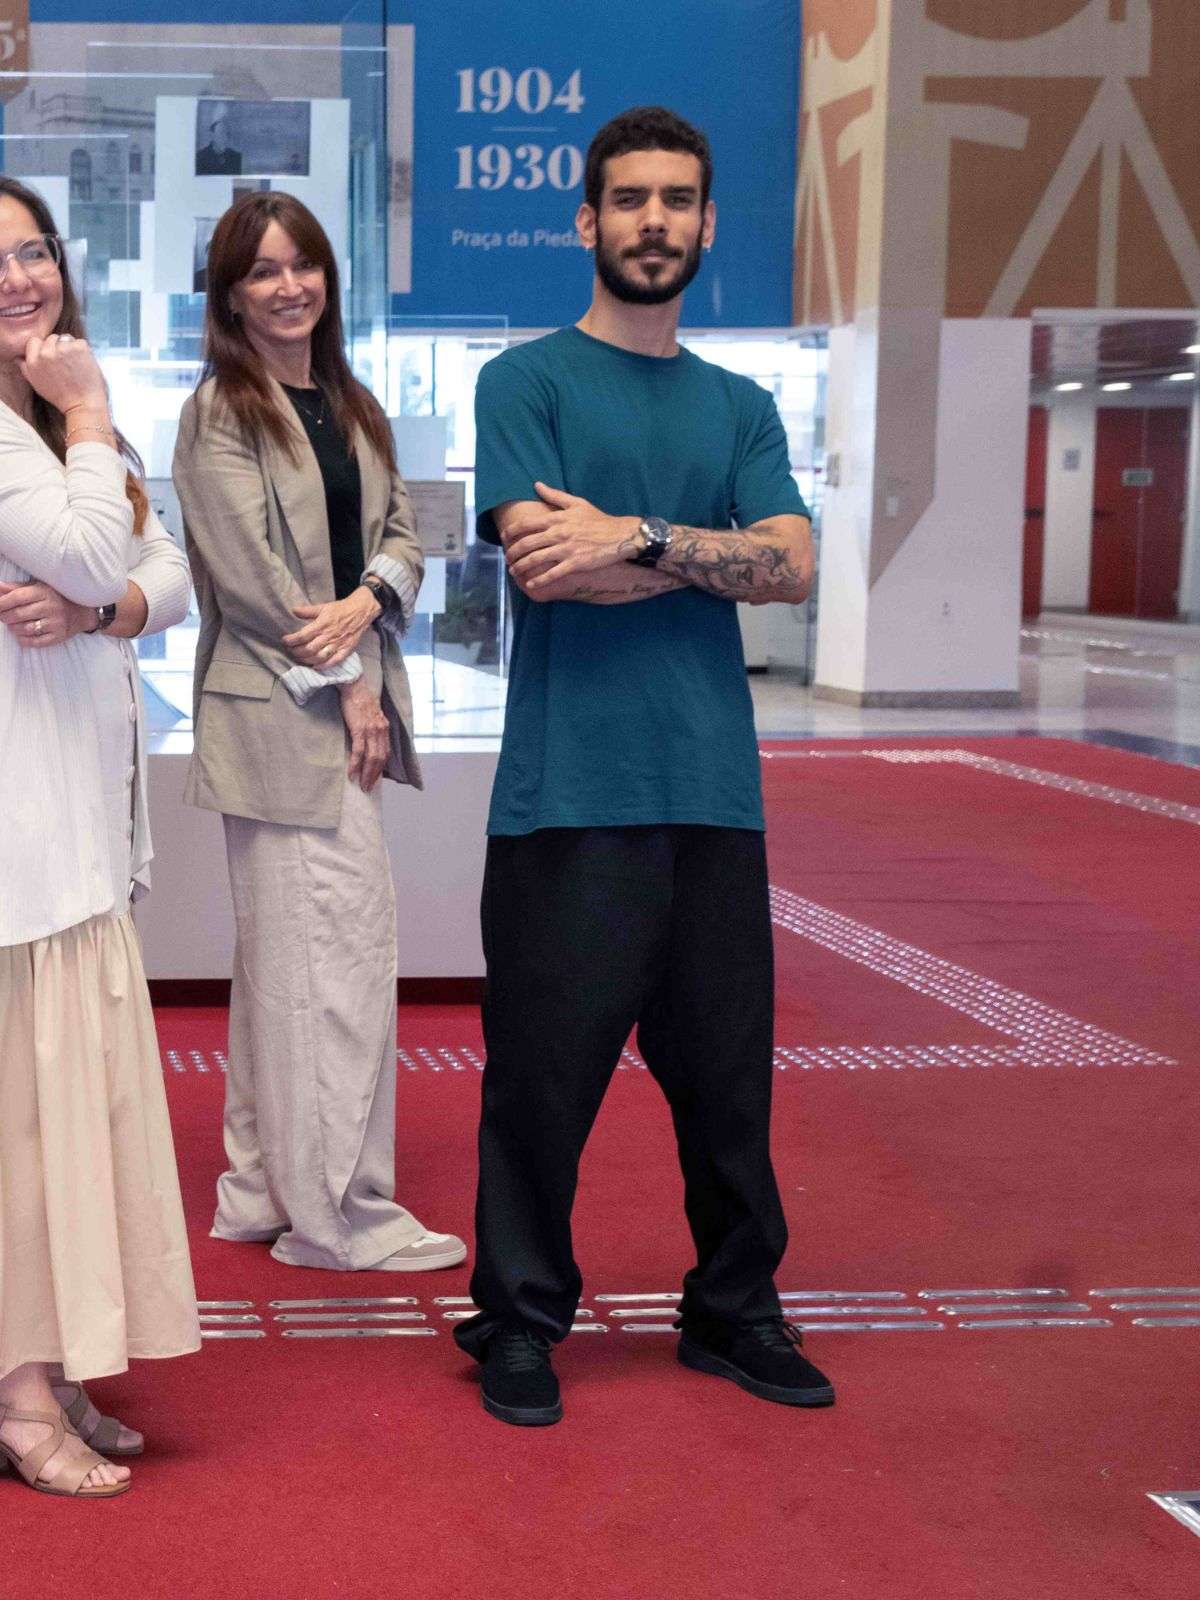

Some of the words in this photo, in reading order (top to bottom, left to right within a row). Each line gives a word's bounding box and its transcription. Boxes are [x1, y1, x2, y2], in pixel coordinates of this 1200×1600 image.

[457, 67, 586, 114] 1904
[455, 144, 584, 191] 1930
[452, 228, 502, 251] Praça
[506, 229, 529, 247] da
